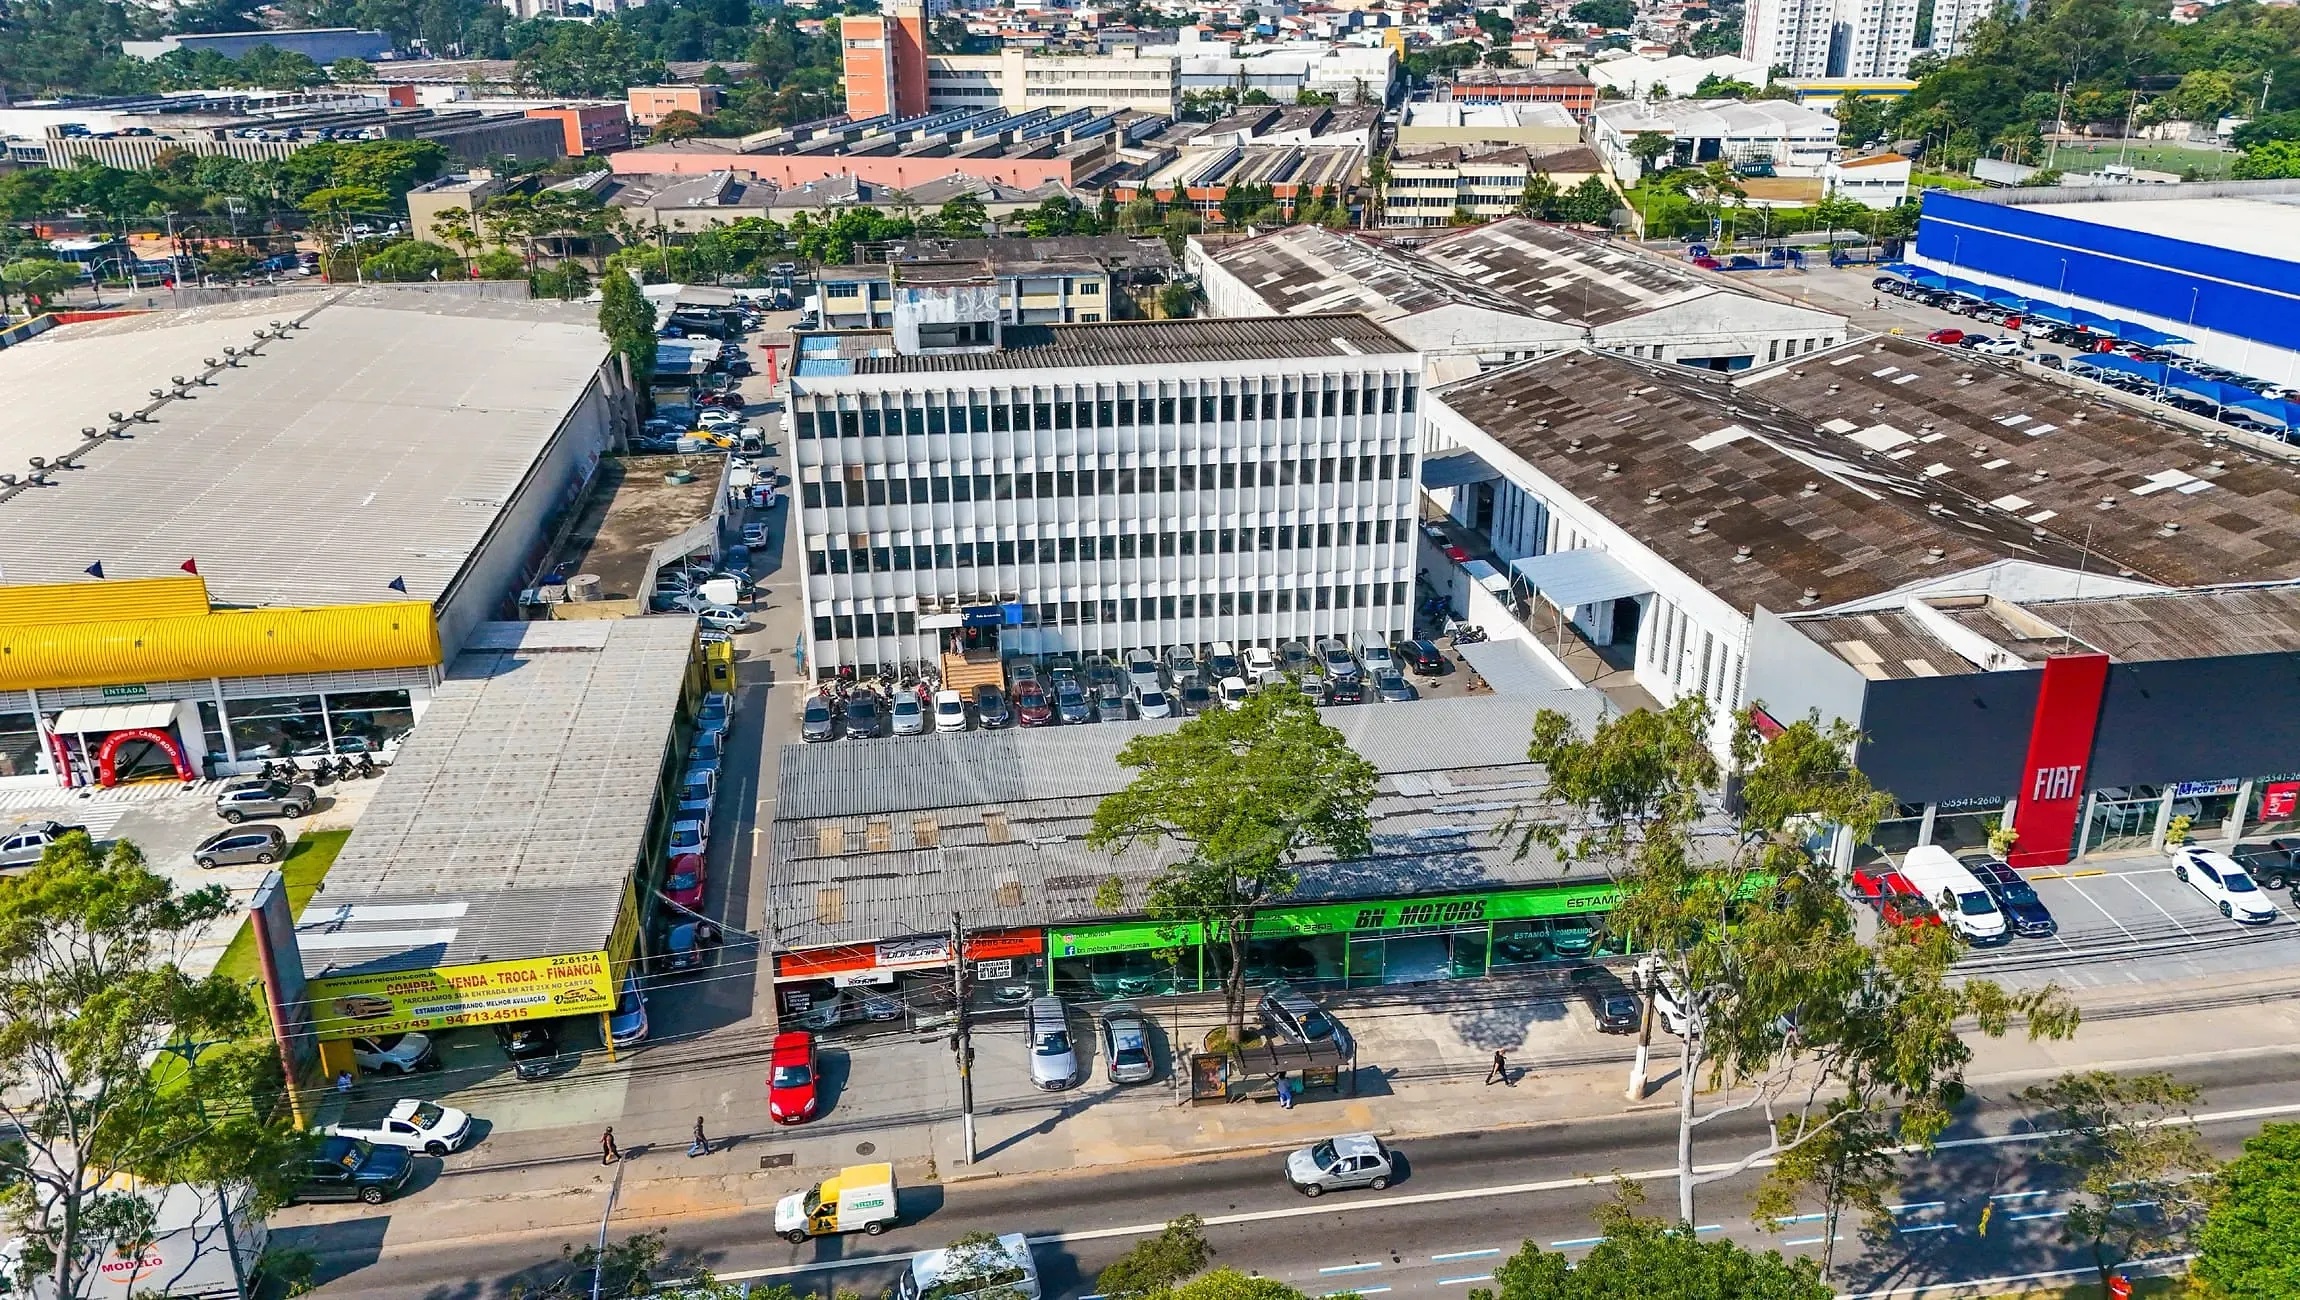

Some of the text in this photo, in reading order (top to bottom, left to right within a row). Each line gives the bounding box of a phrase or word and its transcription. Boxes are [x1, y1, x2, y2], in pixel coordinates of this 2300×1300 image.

[104, 687, 145, 695] ENTRADA
[139, 730, 161, 742] CARRO
[2033, 765, 2081, 801] FIAT
[2192, 786, 2209, 794] PCD
[2216, 783, 2236, 793] TAXI
[1950, 796, 2000, 807] 5541-2600
[1567, 894, 1629, 908] ESTAMO
[1354, 899, 1488, 928] BN MOTORS
[1514, 927, 1593, 939] ESTAMOS COMPRANDO
[386, 979, 438, 996] COMPRA
[447, 974, 488, 990] VENDA
[497, 970, 538, 984] TROCA
[547, 963, 602, 980] FINANCIA
[403, 994, 452, 1004] PARCELAMOS
[472, 988, 506, 998] ENTRADA
[508, 986, 519, 994] EM
[535, 983, 549, 991] 21X
[564, 979, 594, 988] CARTÃO
[415, 1007, 443, 1015] ESTAMOS
[486, 999, 511, 1007] MELHOR
[512, 994, 546, 1005] AVALIAÇÃO
[346, 1007, 528, 1035] 5521-3749 94713.4515
